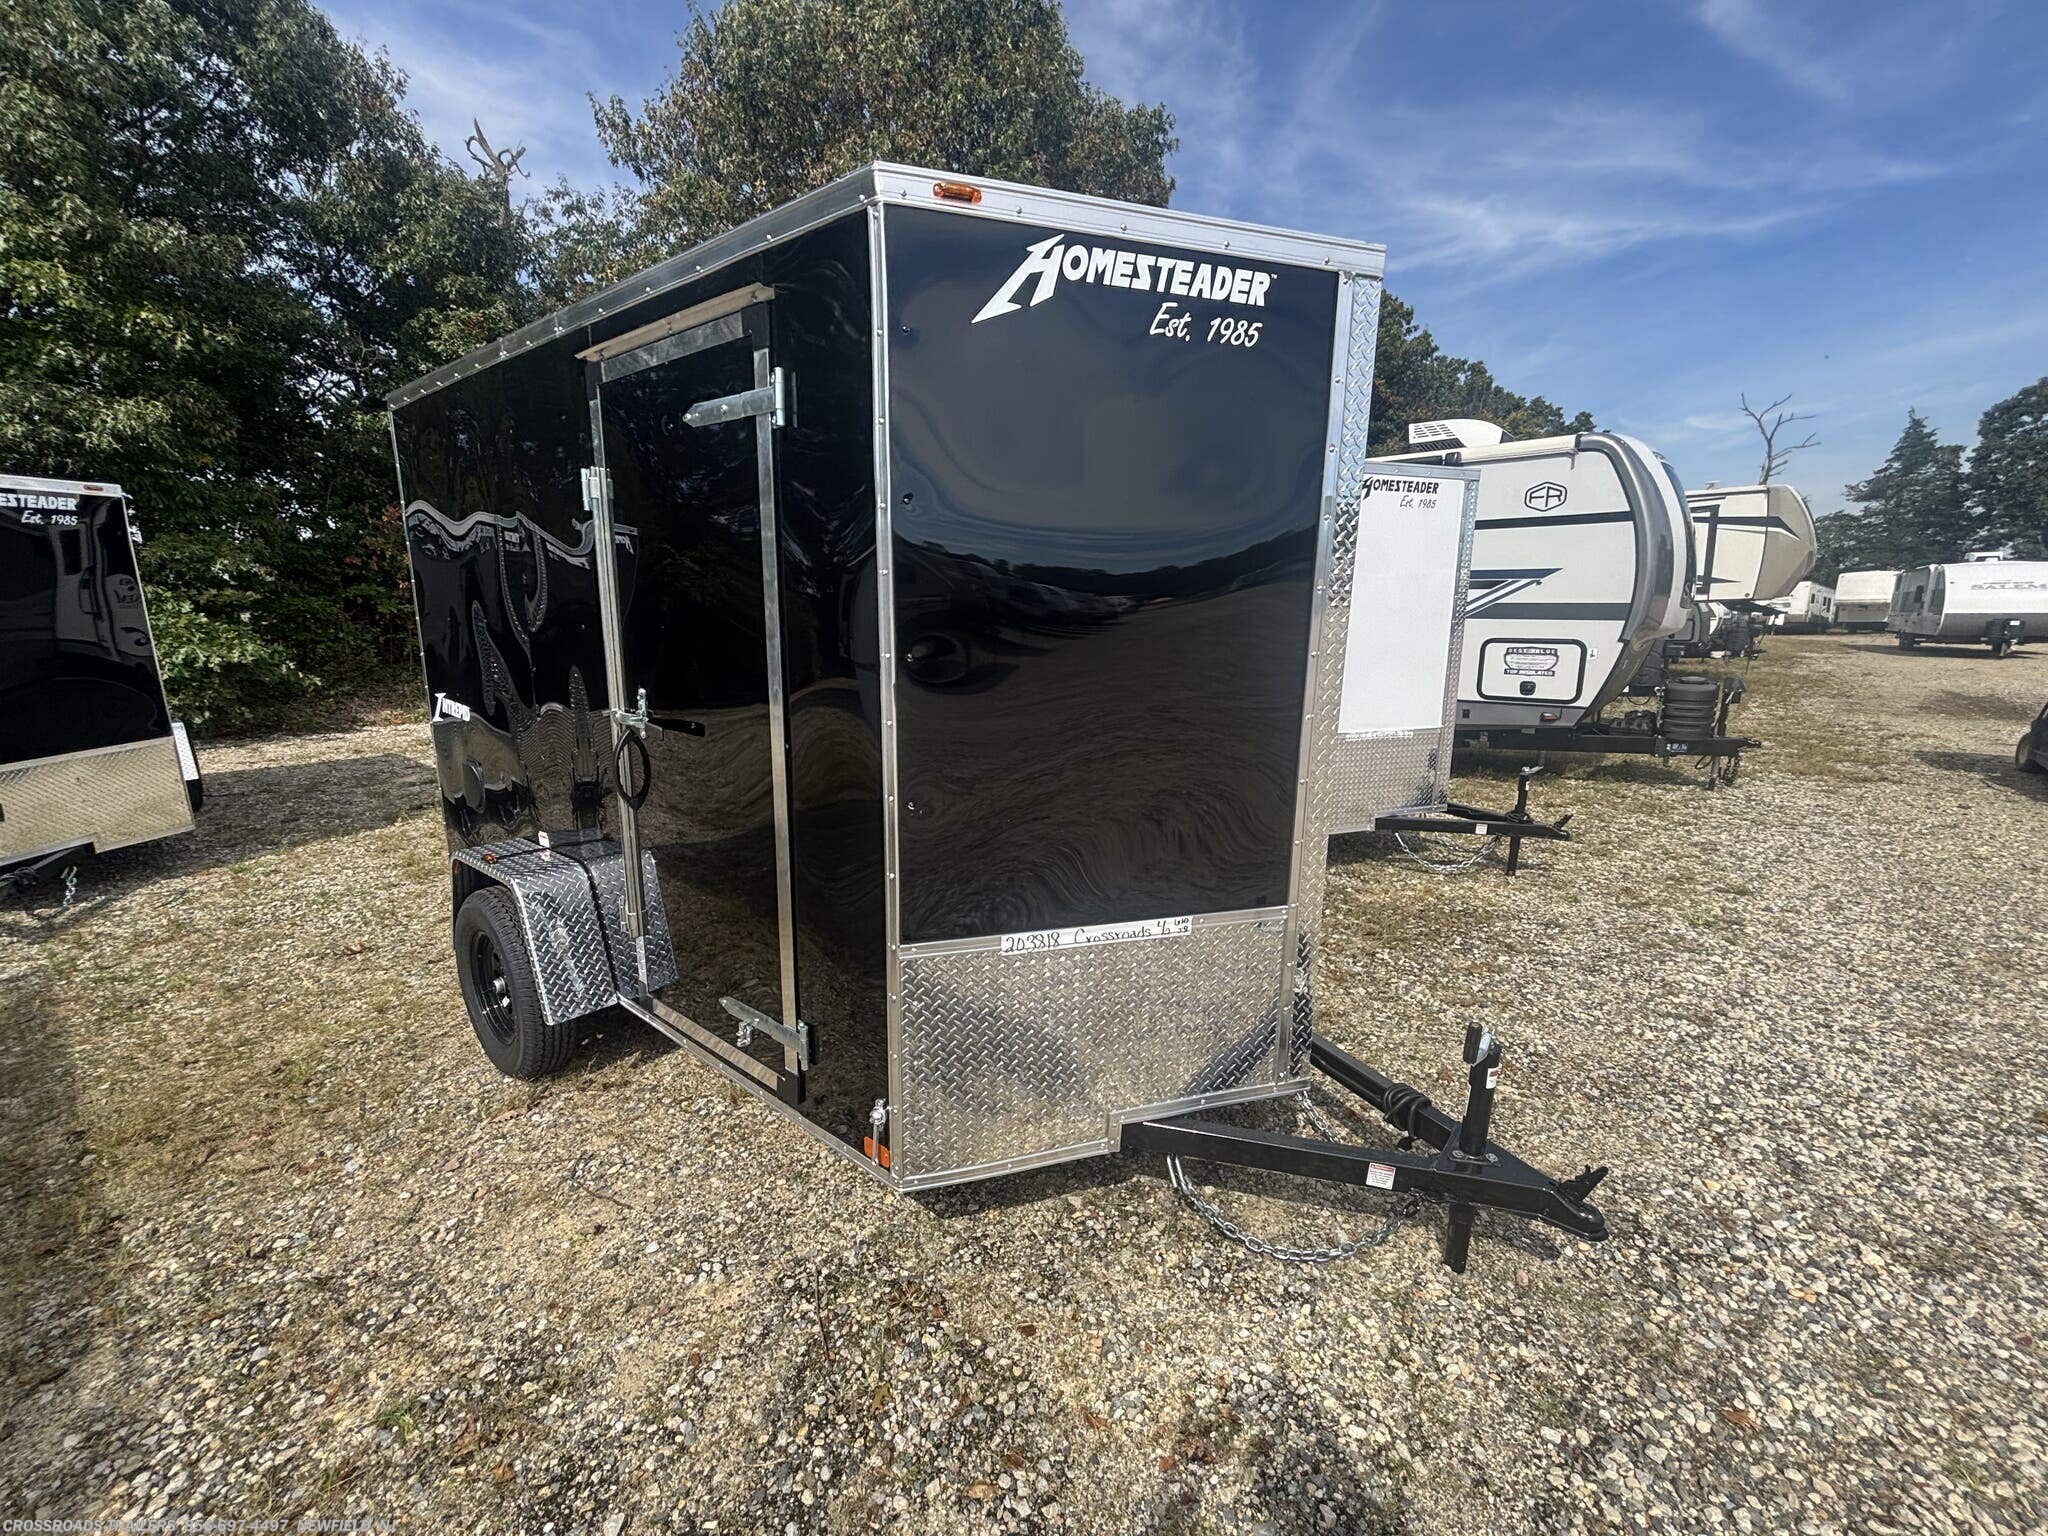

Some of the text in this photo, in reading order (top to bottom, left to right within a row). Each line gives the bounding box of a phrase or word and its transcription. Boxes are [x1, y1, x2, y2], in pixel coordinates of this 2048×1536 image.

[971, 233, 1271, 324] HOMESTEADER
[1149, 302, 1263, 347] Est. 1985
[1418, 498, 1437, 509] 1985
[50, 514, 79, 526] 1985
[1005, 932, 1061, 952] 203818
